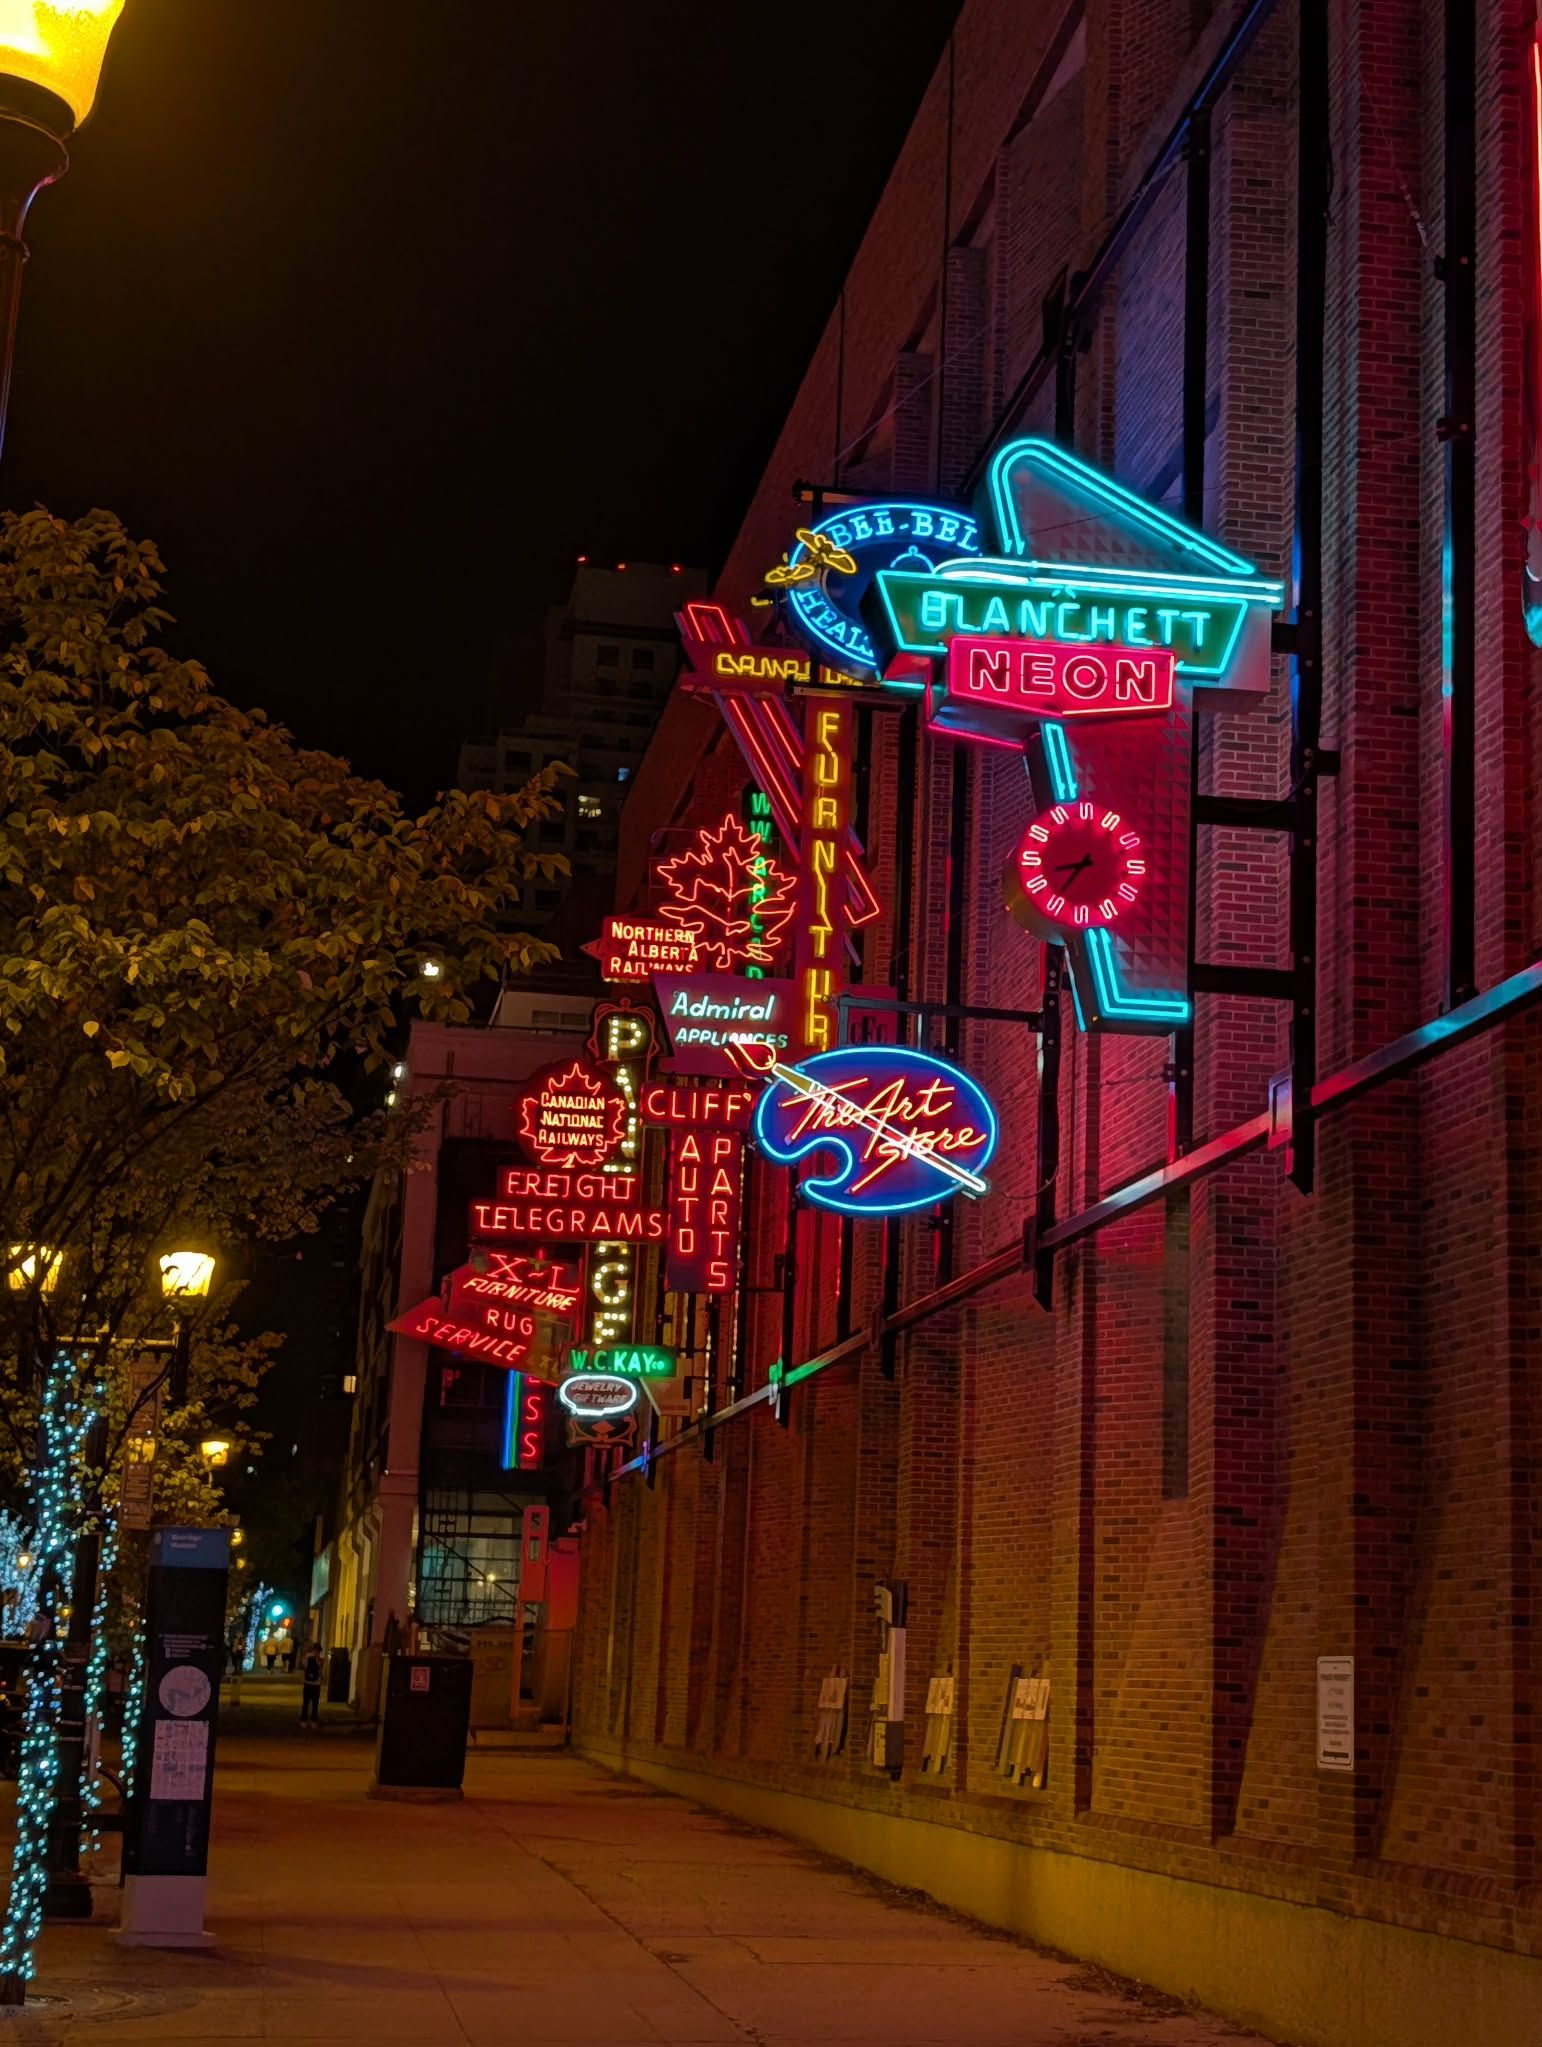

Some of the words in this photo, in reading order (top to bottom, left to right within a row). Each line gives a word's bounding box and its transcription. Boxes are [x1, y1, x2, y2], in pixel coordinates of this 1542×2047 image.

[825, 510, 981, 556] BEE-BEL
[795, 587, 876, 659] HEAL
[921, 589, 1211, 647] BLANCHETT
[969, 647, 1156, 702] NEON
[810, 711, 841, 1052] FURNITUR
[611, 921, 695, 944] NORTHERN
[628, 940, 699, 962] ALBERTA
[670, 990, 776, 1021] Admiral
[539, 1110, 605, 1129] NATIONAL
[540, 1090, 606, 1111] CANADIAN
[852, 1077, 955, 1160] Art
[538, 1128, 604, 1147] RAILWAYS
[850, 1125, 987, 1193] Store
[507, 1171, 636, 1200] FREIGHT
[678, 1134, 701, 1253] AUTO
[474, 1204, 663, 1238] TELEGRAMS
[708, 1137, 733, 1287] PARTS
[462, 1276, 577, 1312] FURNITURE
[415, 1316, 528, 1362] SERVICE
[486, 1308, 534, 1336] RUG
